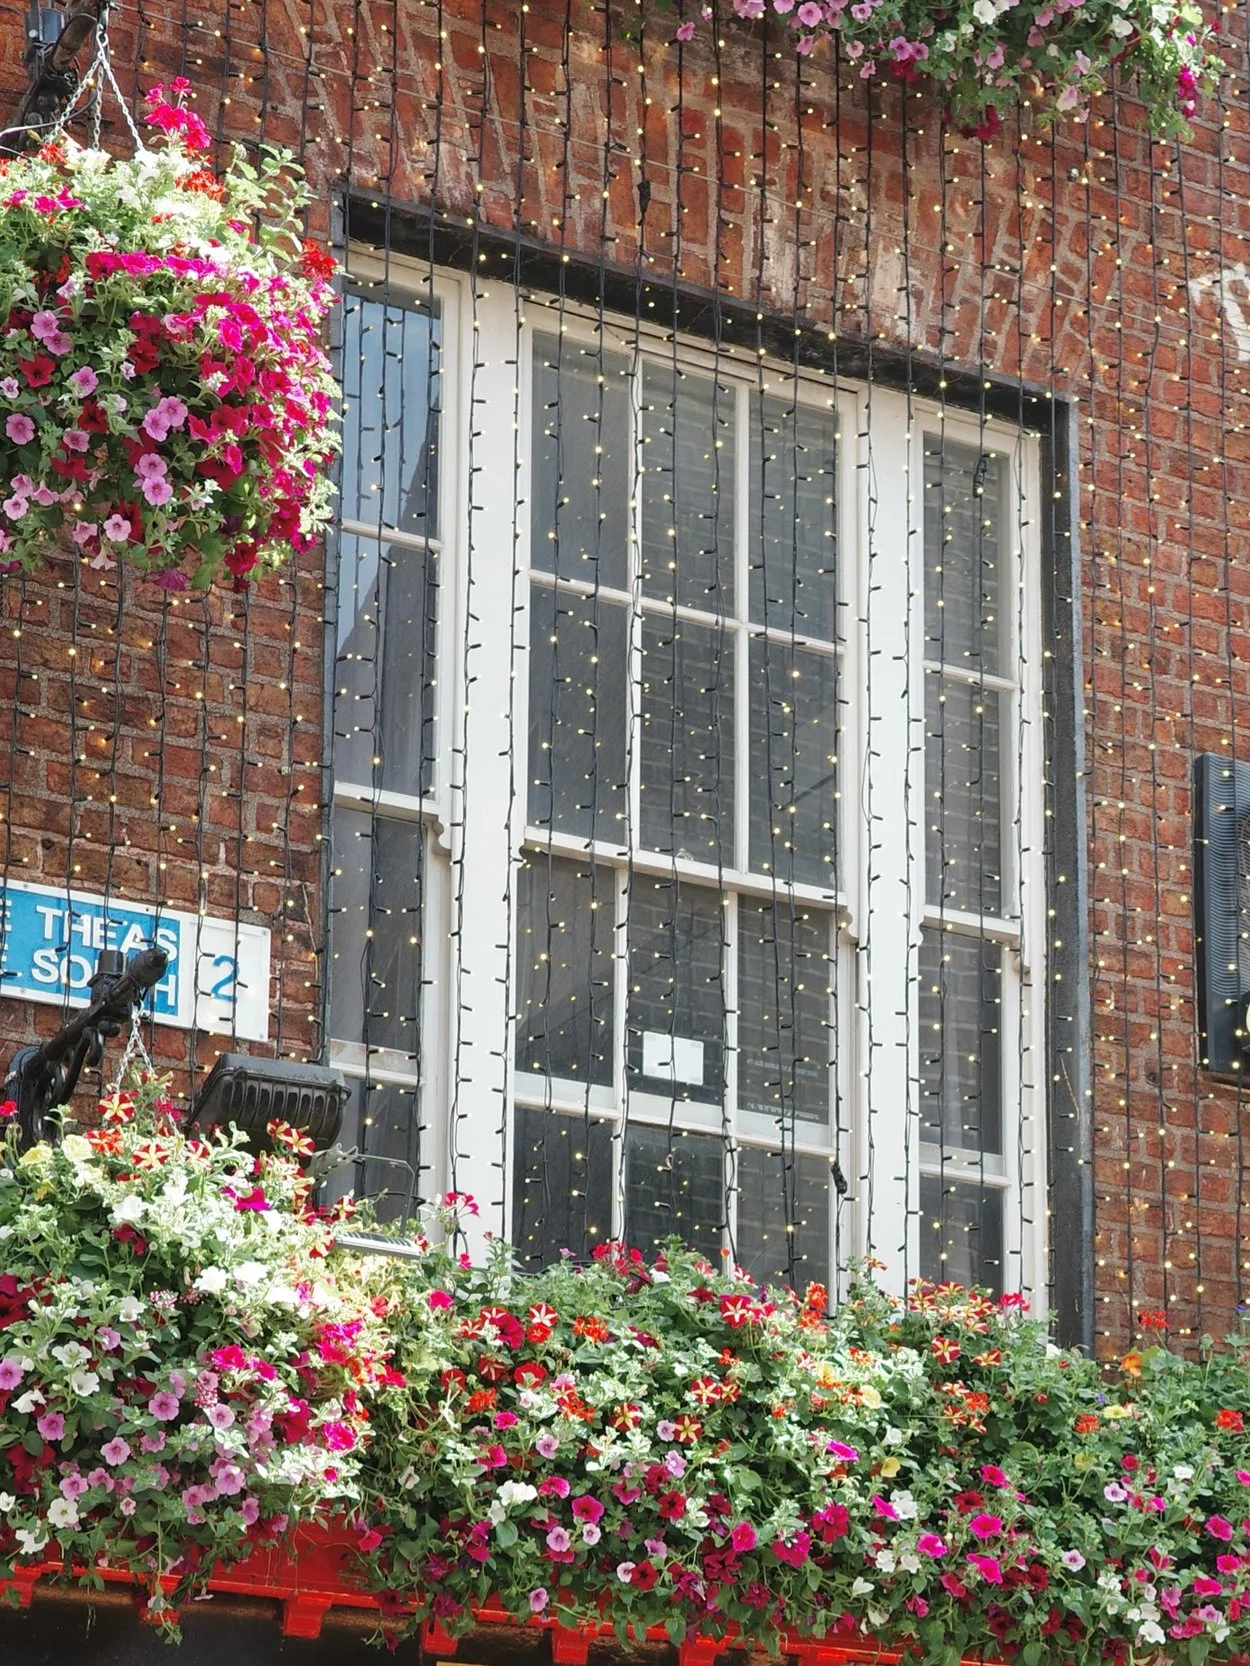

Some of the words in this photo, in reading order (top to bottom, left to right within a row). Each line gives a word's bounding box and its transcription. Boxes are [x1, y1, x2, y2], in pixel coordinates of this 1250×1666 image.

[36, 904, 177, 962] THEAS
[31, 947, 176, 1007] SOH
[210, 955, 240, 1002] 2
